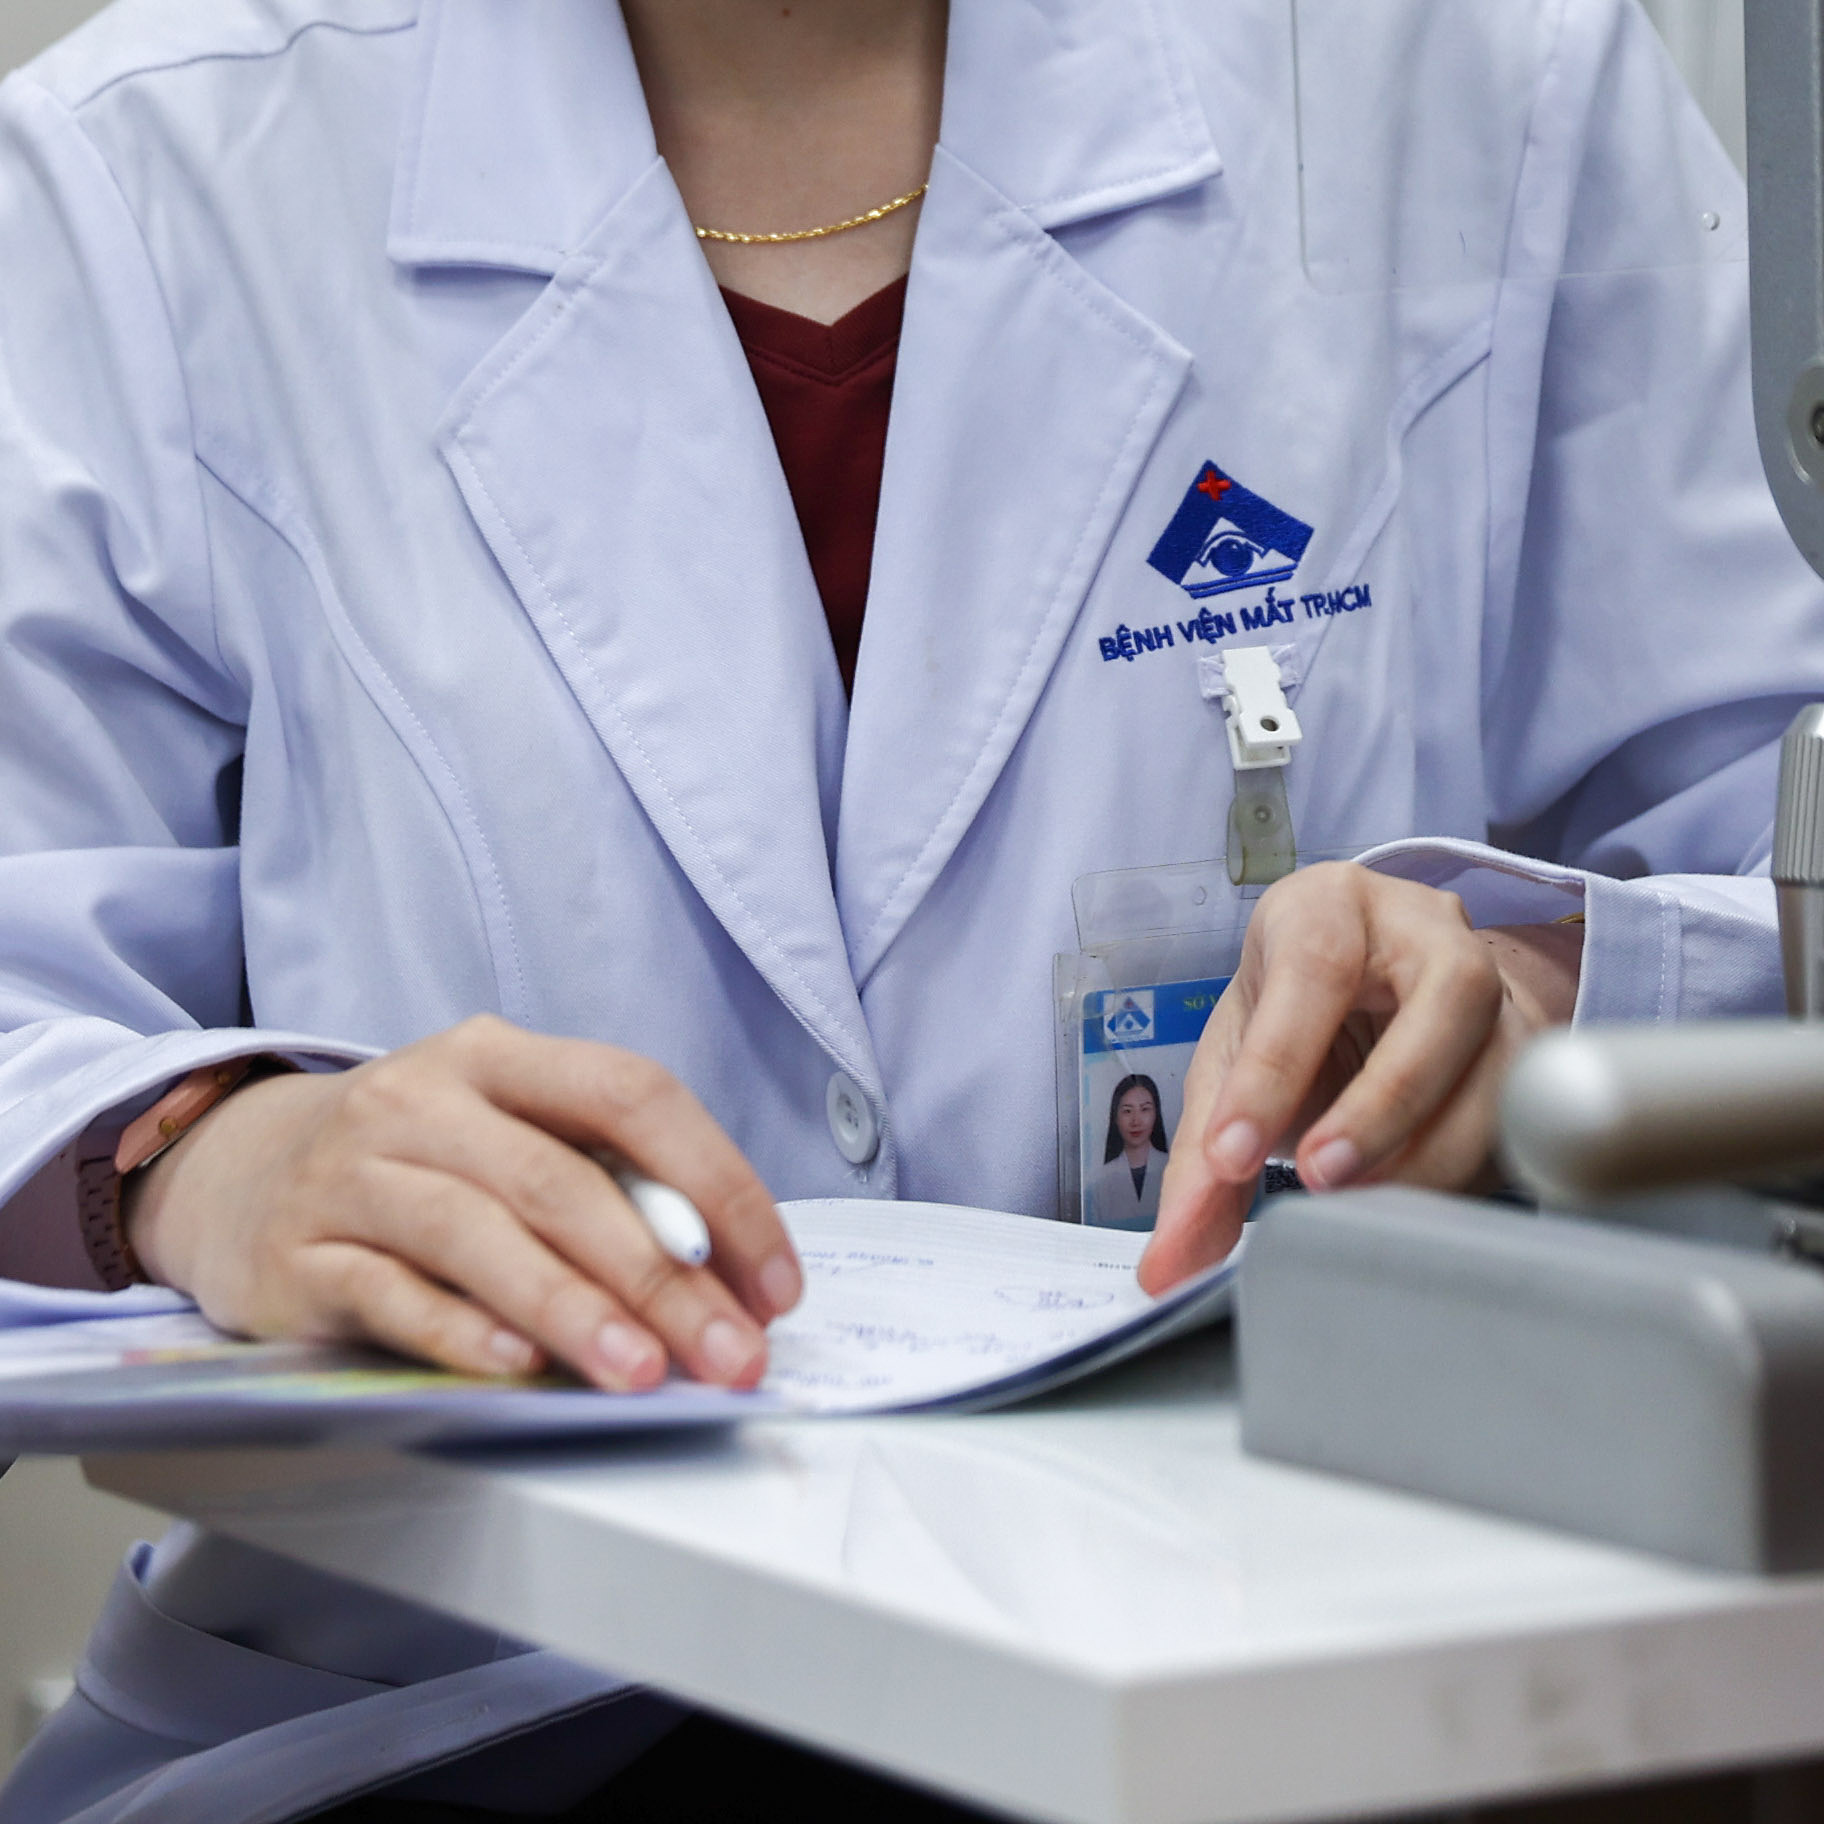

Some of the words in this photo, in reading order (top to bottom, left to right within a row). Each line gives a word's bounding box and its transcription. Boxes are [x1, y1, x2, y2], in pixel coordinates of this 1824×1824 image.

[1099, 623, 1175, 662] BỆNH
[1177, 607, 1237, 644] VIỆN
[1239, 586, 1295, 632] MẮT
[1300, 584, 1372, 619] TP.HCM
